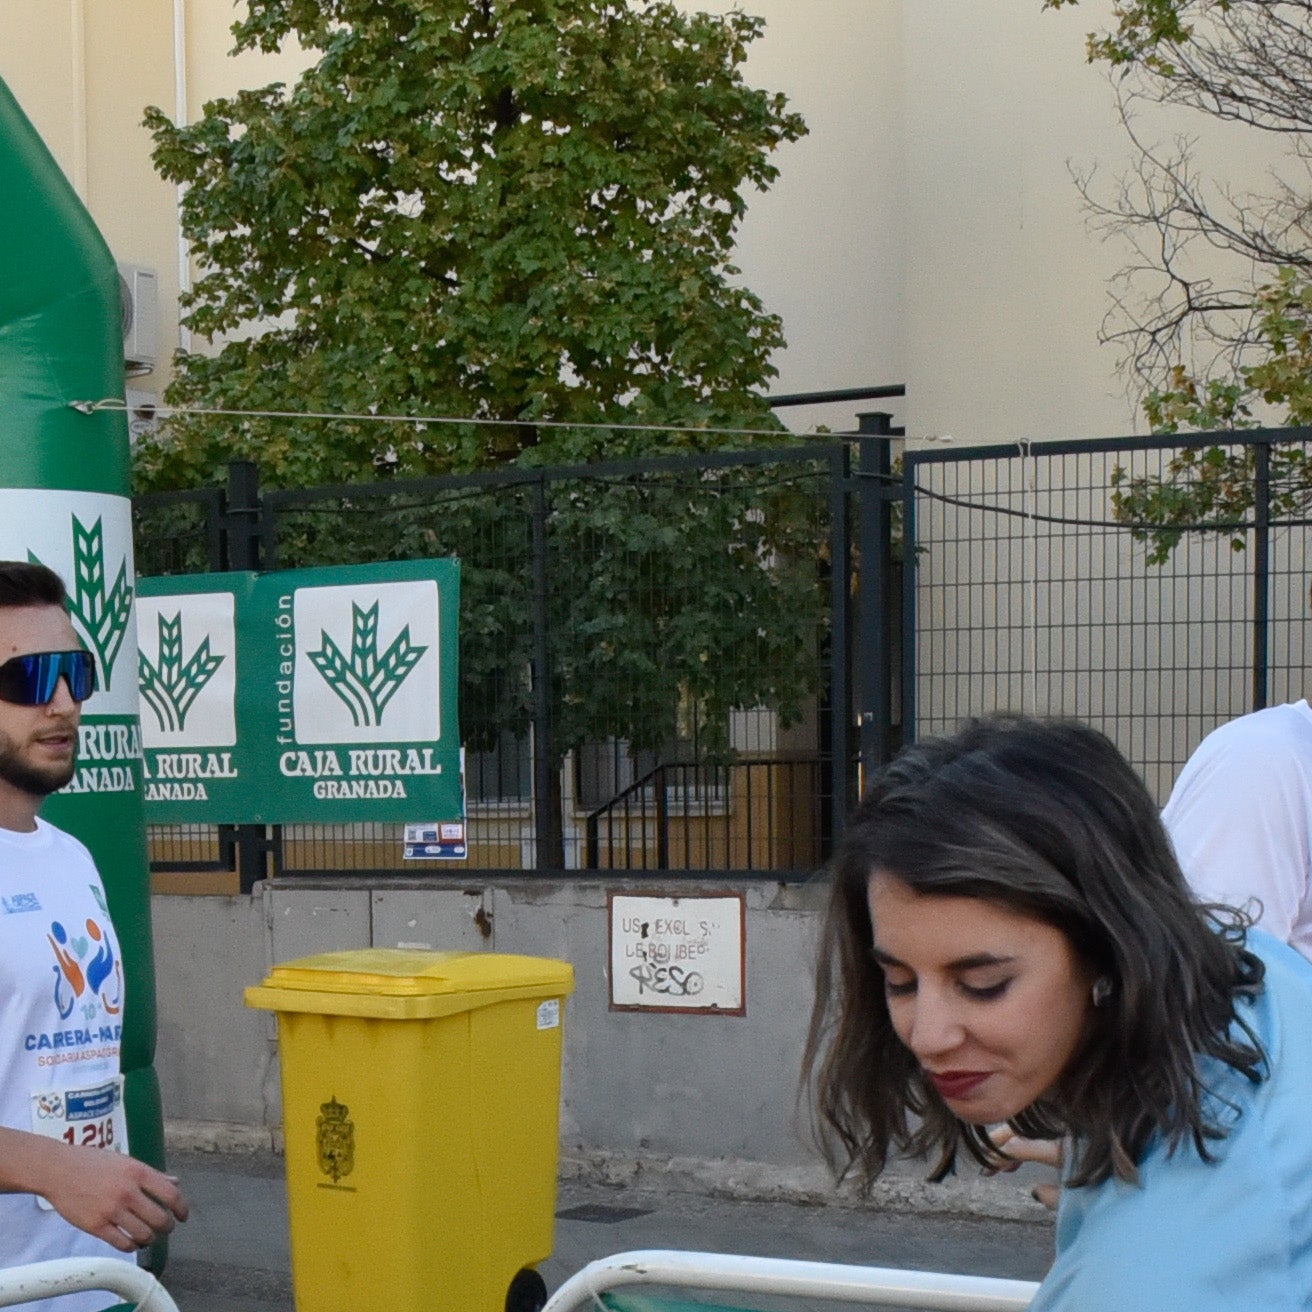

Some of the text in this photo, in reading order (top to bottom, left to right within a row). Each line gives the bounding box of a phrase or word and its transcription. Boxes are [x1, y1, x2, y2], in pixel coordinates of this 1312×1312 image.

[276, 595, 293, 746] fundación
[155, 752, 238, 779] RURAL
[279, 749, 442, 778] CAJA RURAL
[56, 767, 135, 794] ANADA
[144, 782, 208, 800] ANADA
[313, 780, 407, 799] GRANADA
[63, 1118, 114, 1149] 1218
